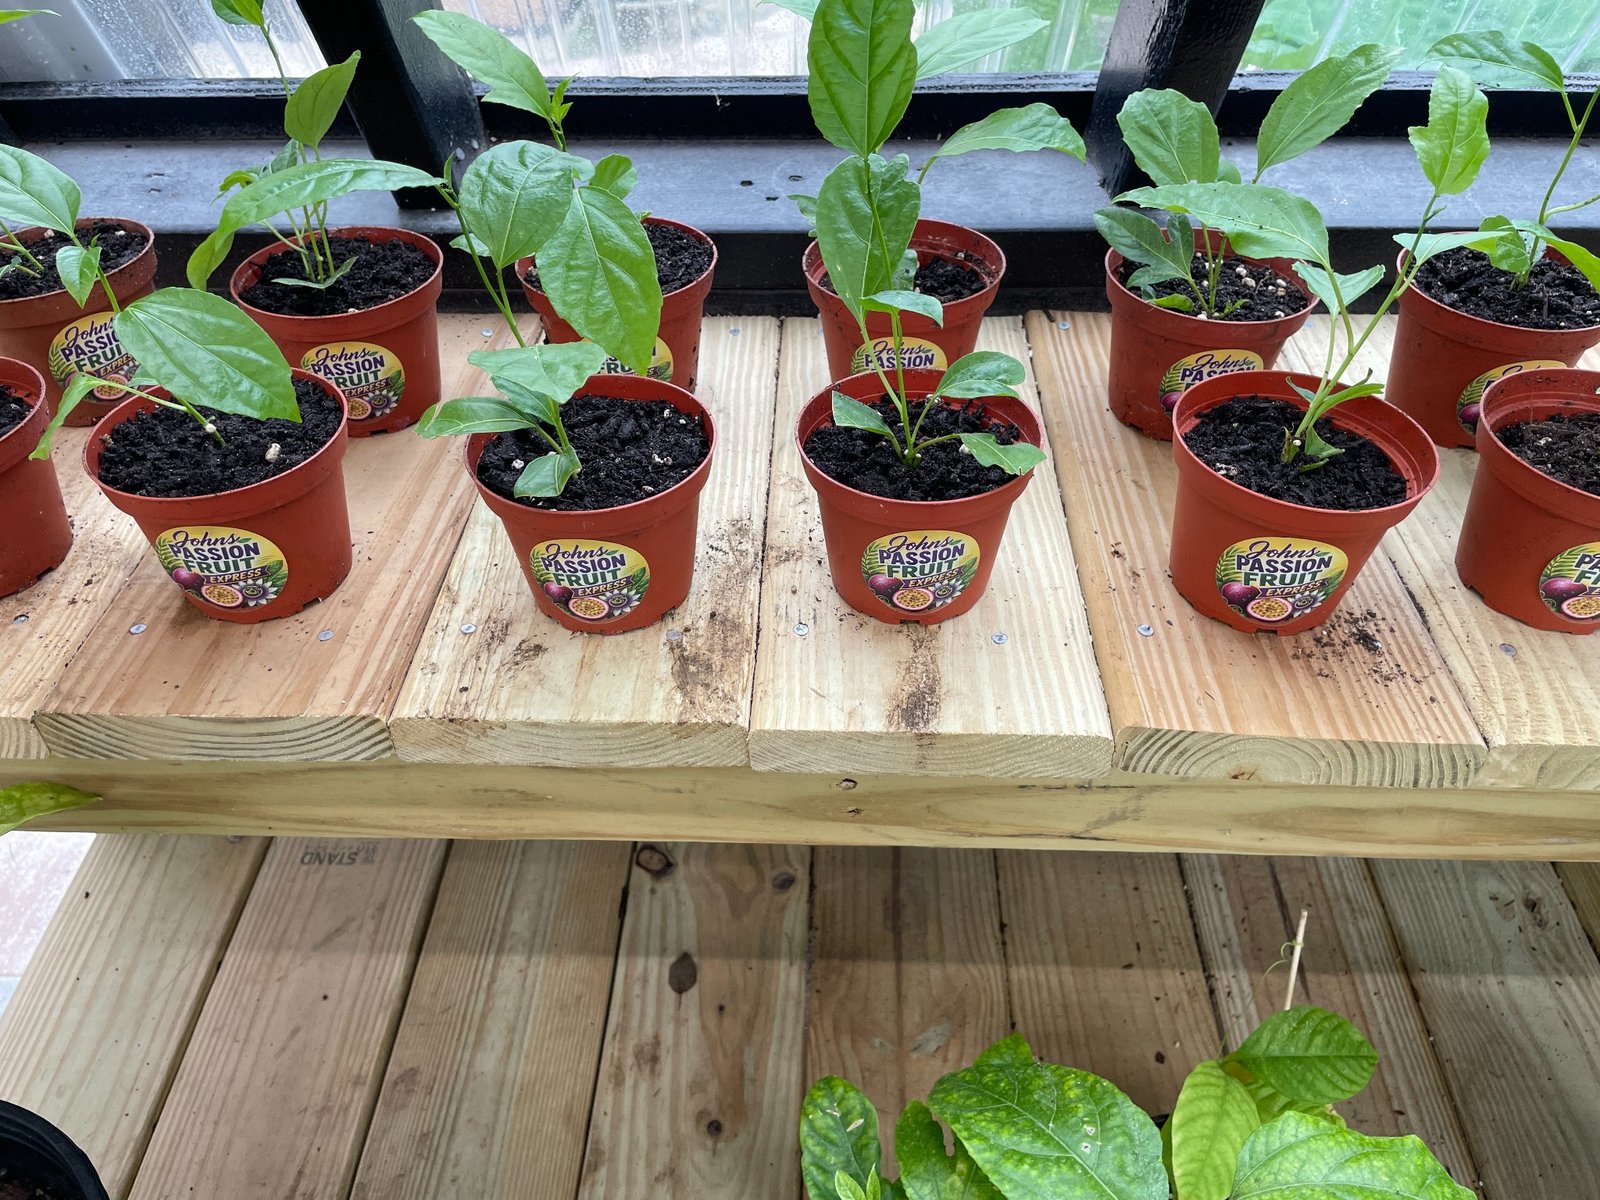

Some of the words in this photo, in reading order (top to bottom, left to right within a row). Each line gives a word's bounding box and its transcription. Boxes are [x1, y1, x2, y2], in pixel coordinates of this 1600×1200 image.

[74, 344, 122, 373] FRUI
[310, 355, 385, 376] PASSION
[315, 347, 370, 366] Johns
[1191, 354, 1249, 371] Johns
[345, 380, 386, 397] EXPRESS
[172, 530, 240, 548] Johns
[888, 535, 954, 553] Johns
[168, 542, 260, 561] PASSION
[545, 543, 608, 560] Johns
[878, 544, 965, 565] PASSION
[1246, 540, 1320, 559] Johns
[183, 557, 254, 574] FRUIT
[541, 554, 626, 574] PASSION
[887, 558, 957, 577] FRUIT
[1236, 555, 1332, 573] PASSION
[210, 568, 262, 584] EXPRESS
[553, 568, 621, 586] FRUIT
[909, 568, 959, 587] EXPRESS
[1243, 570, 1322, 587] FRUIT
[578, 579, 627, 596] EXPRESS
[1266, 580, 1323, 596] EXPRESS
[300, 851, 359, 866] STAND
